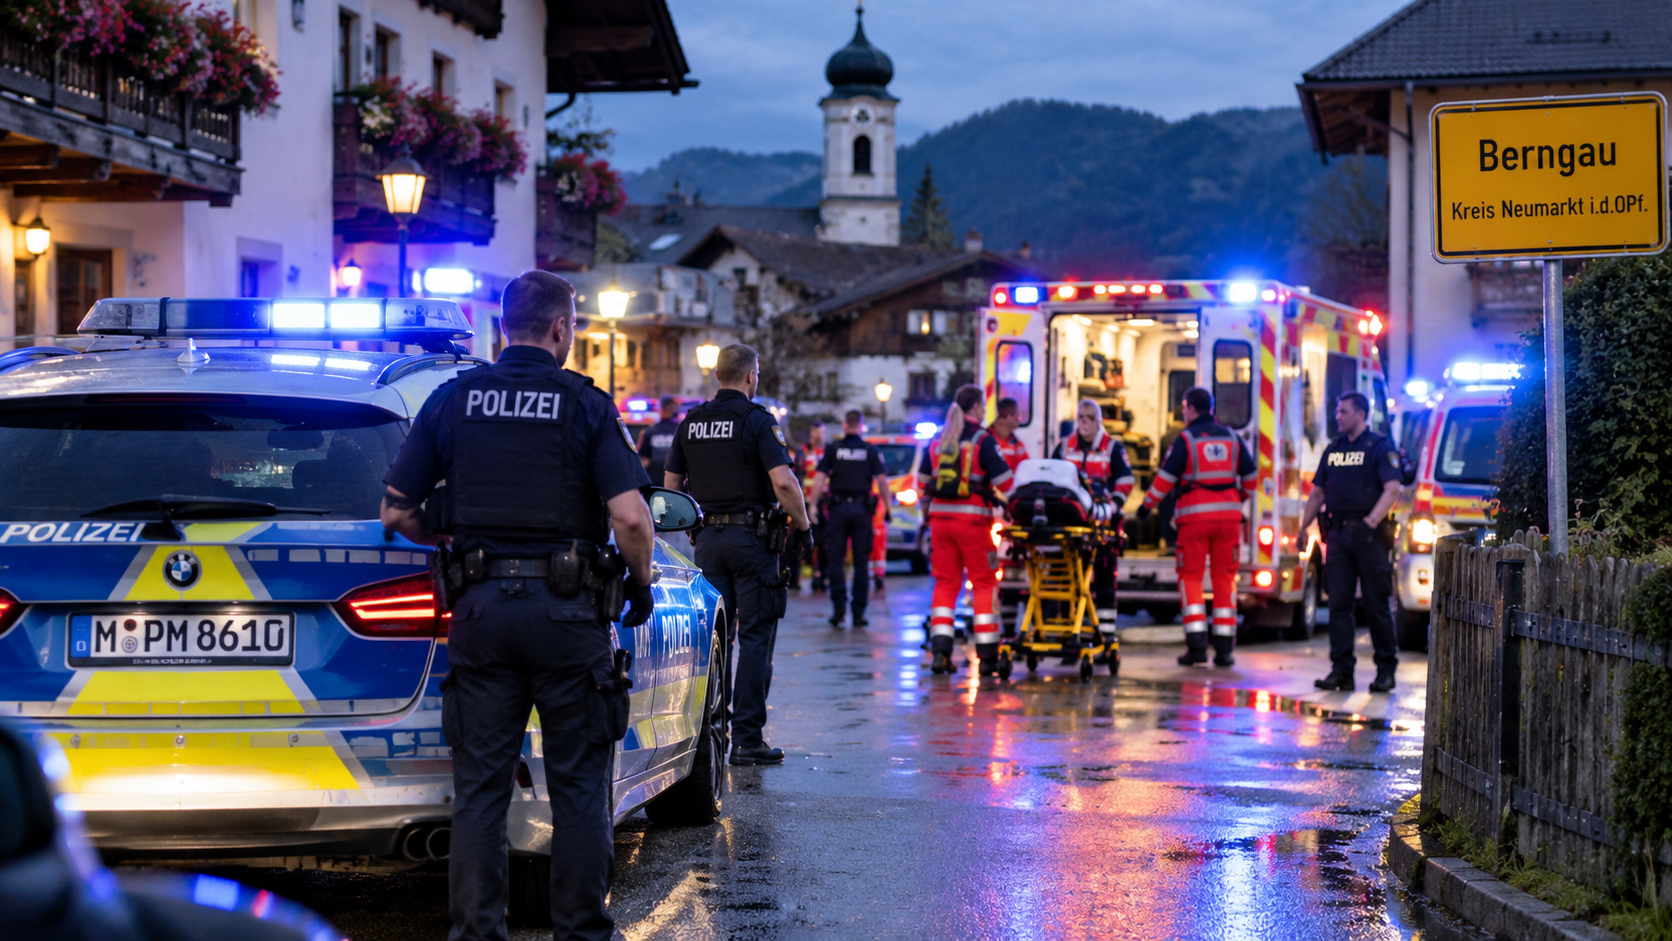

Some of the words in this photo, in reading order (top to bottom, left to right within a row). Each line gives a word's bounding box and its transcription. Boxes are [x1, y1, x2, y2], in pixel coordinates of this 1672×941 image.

[1479, 138, 1617, 177] Berngau
[1452, 201, 1495, 220] Kreis
[1501, 197, 1584, 218] Neumarkt
[466, 389, 560, 419] POLIZEI
[688, 421, 734, 440] POLIZEI
[1327, 451, 1365, 467] POLIZEI
[0, 522, 146, 543] POLIZEI
[95, 620, 117, 653] M
[144, 619, 188, 652] PM
[196, 619, 285, 652] 8610
